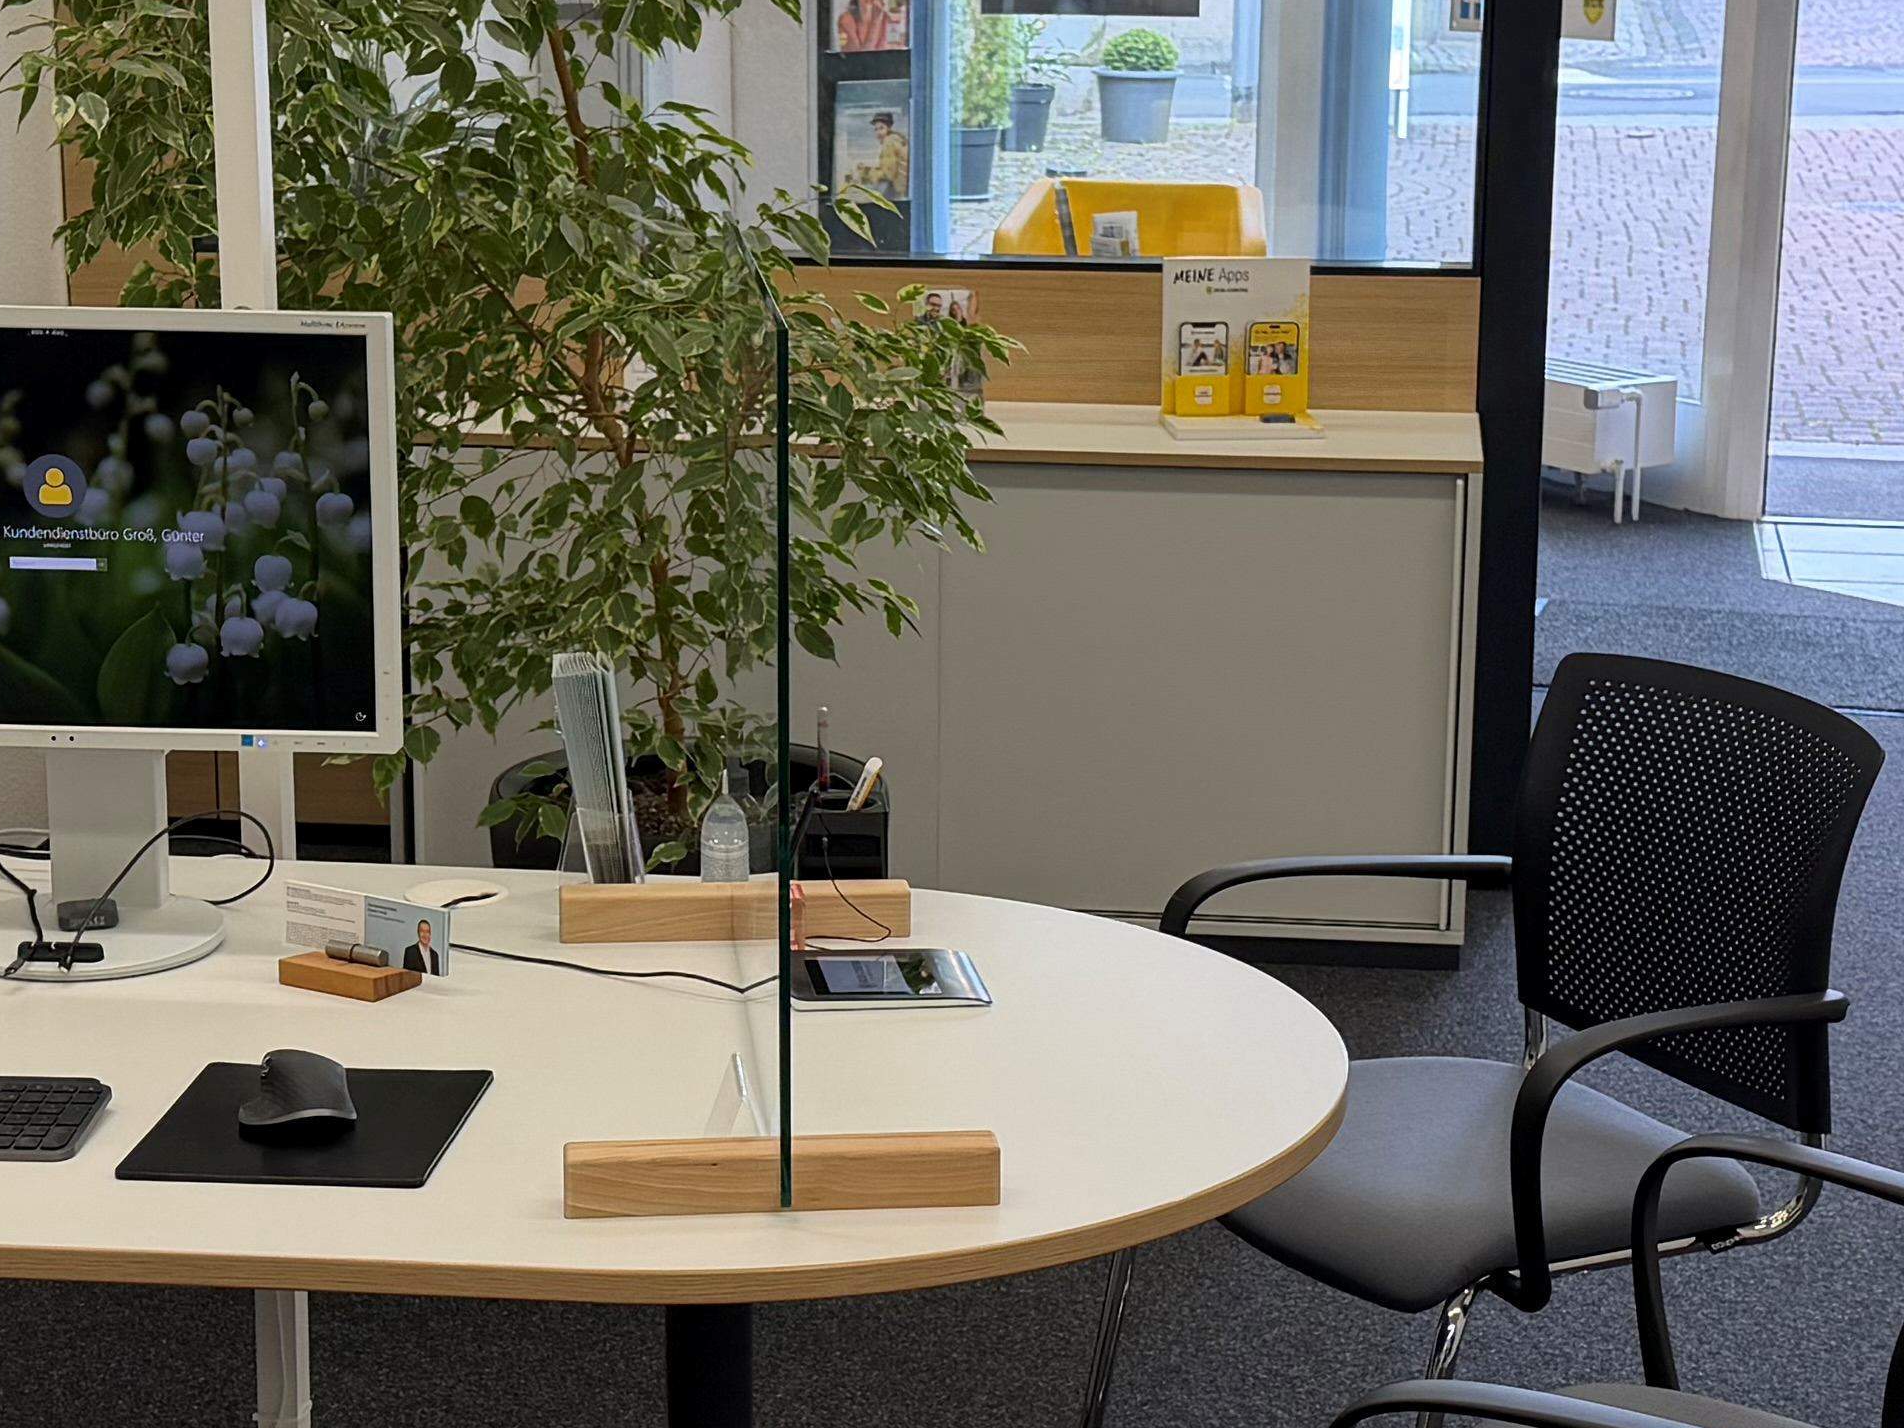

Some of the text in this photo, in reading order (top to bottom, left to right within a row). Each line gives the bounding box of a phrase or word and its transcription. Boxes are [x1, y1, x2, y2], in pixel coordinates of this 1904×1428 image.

[1173, 268, 1250, 285] MEINE Apps
[3, 524, 120, 541] Kundendienstbüro
[161, 528, 205, 544] Günter
